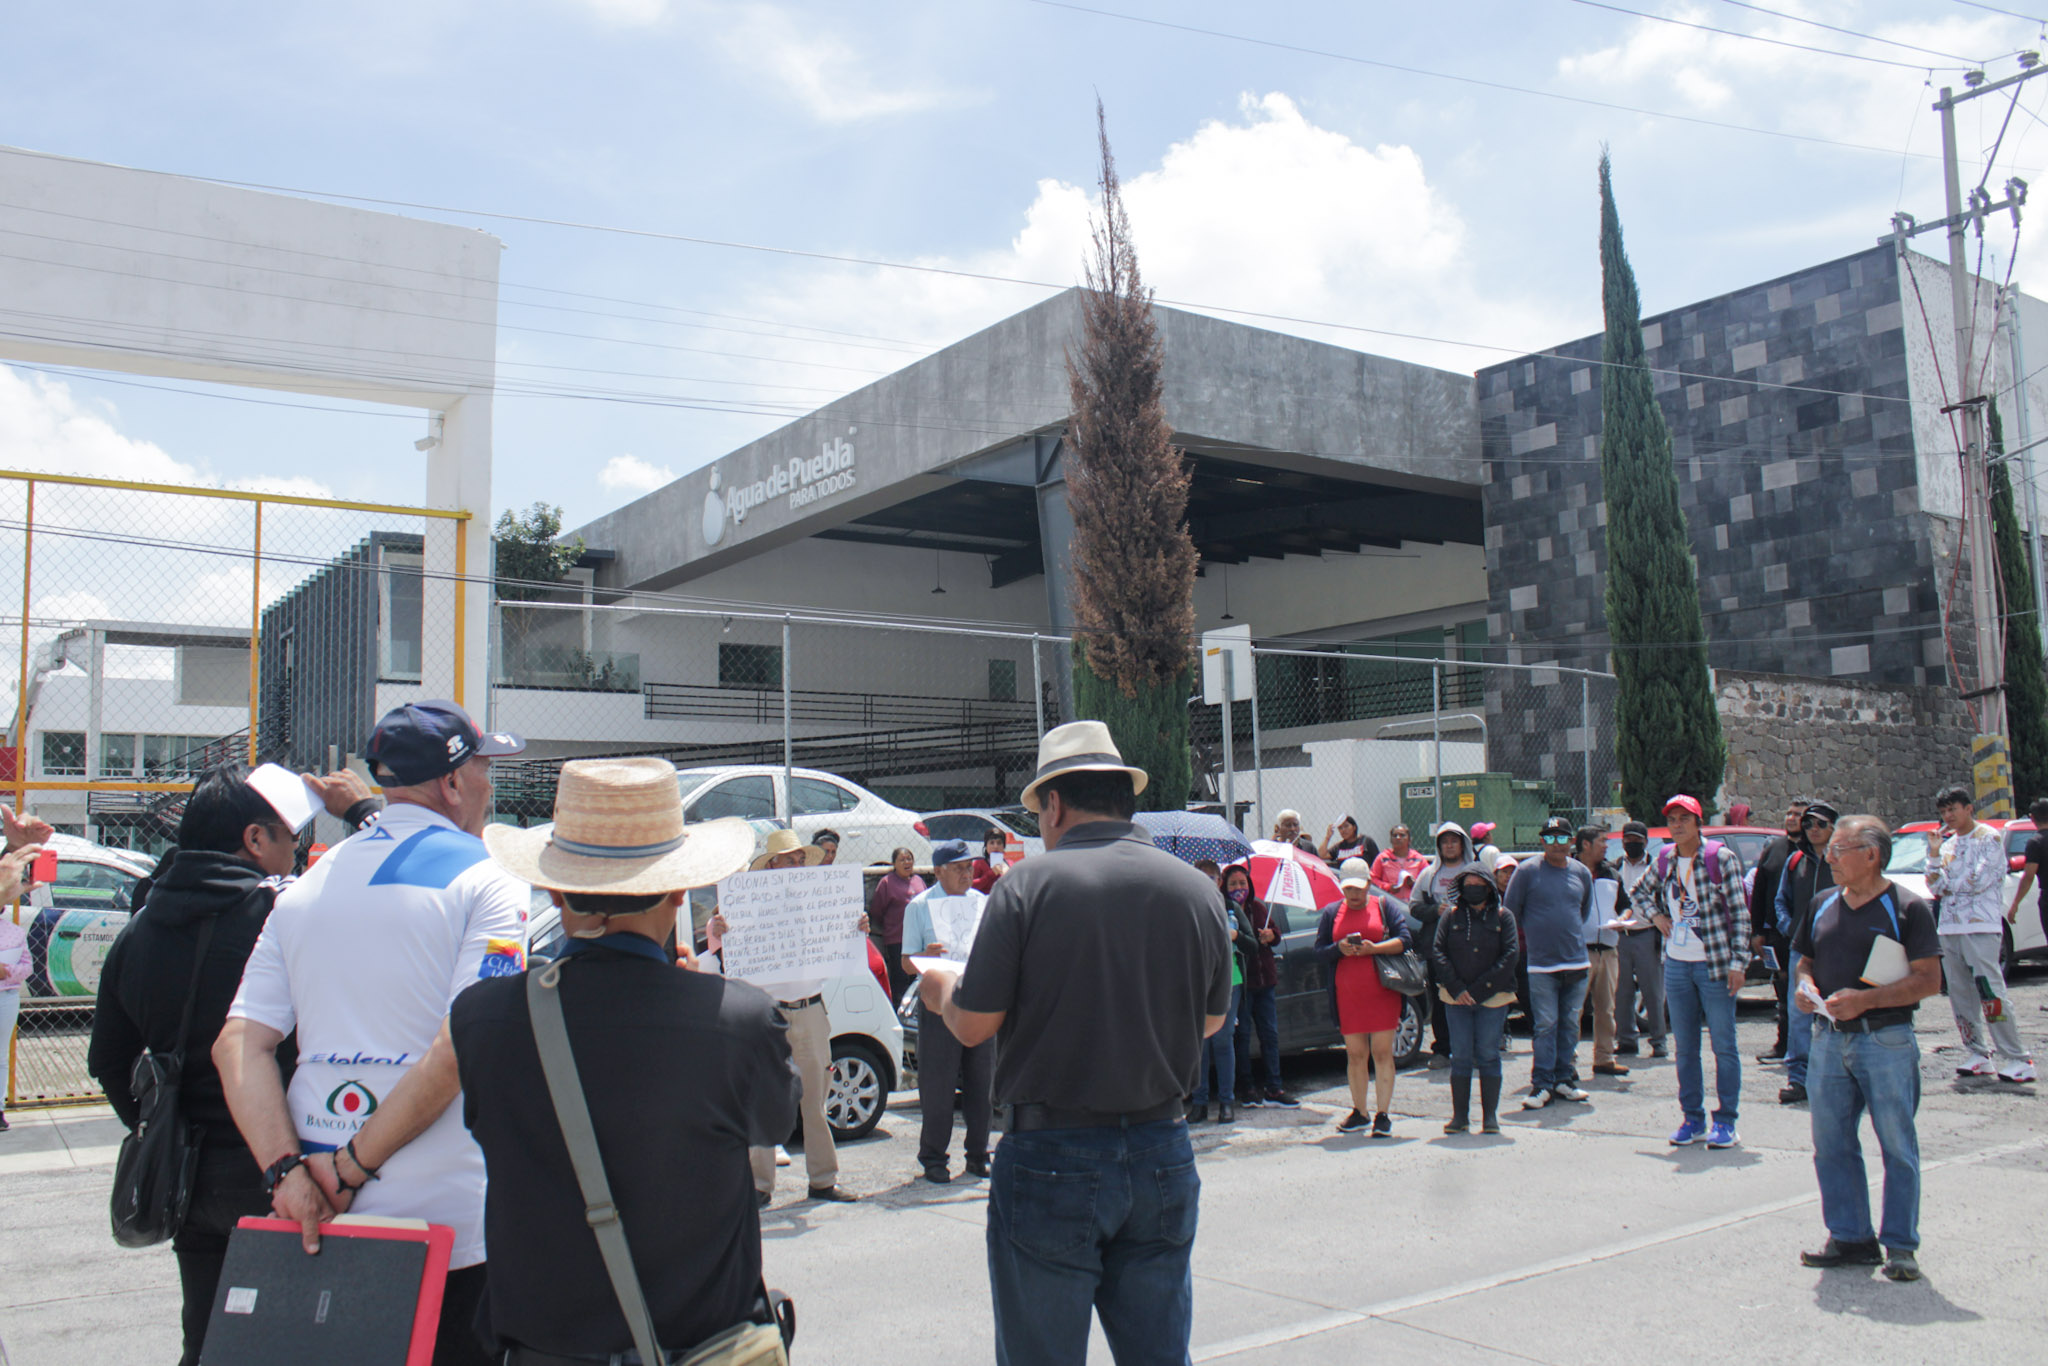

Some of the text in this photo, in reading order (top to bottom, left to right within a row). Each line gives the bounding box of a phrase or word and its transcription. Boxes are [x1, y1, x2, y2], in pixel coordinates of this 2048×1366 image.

[726, 437, 855, 525] Agua de Puebla
[789, 469, 855, 510] PARA TODOS
[728, 875, 768, 892] COLONIA
[788, 871, 817, 884] PEDRO
[823, 870, 850, 882] DESDE
[83, 933, 114, 942] ESTAMOS
[306, 1114, 346, 1131] BANCO
